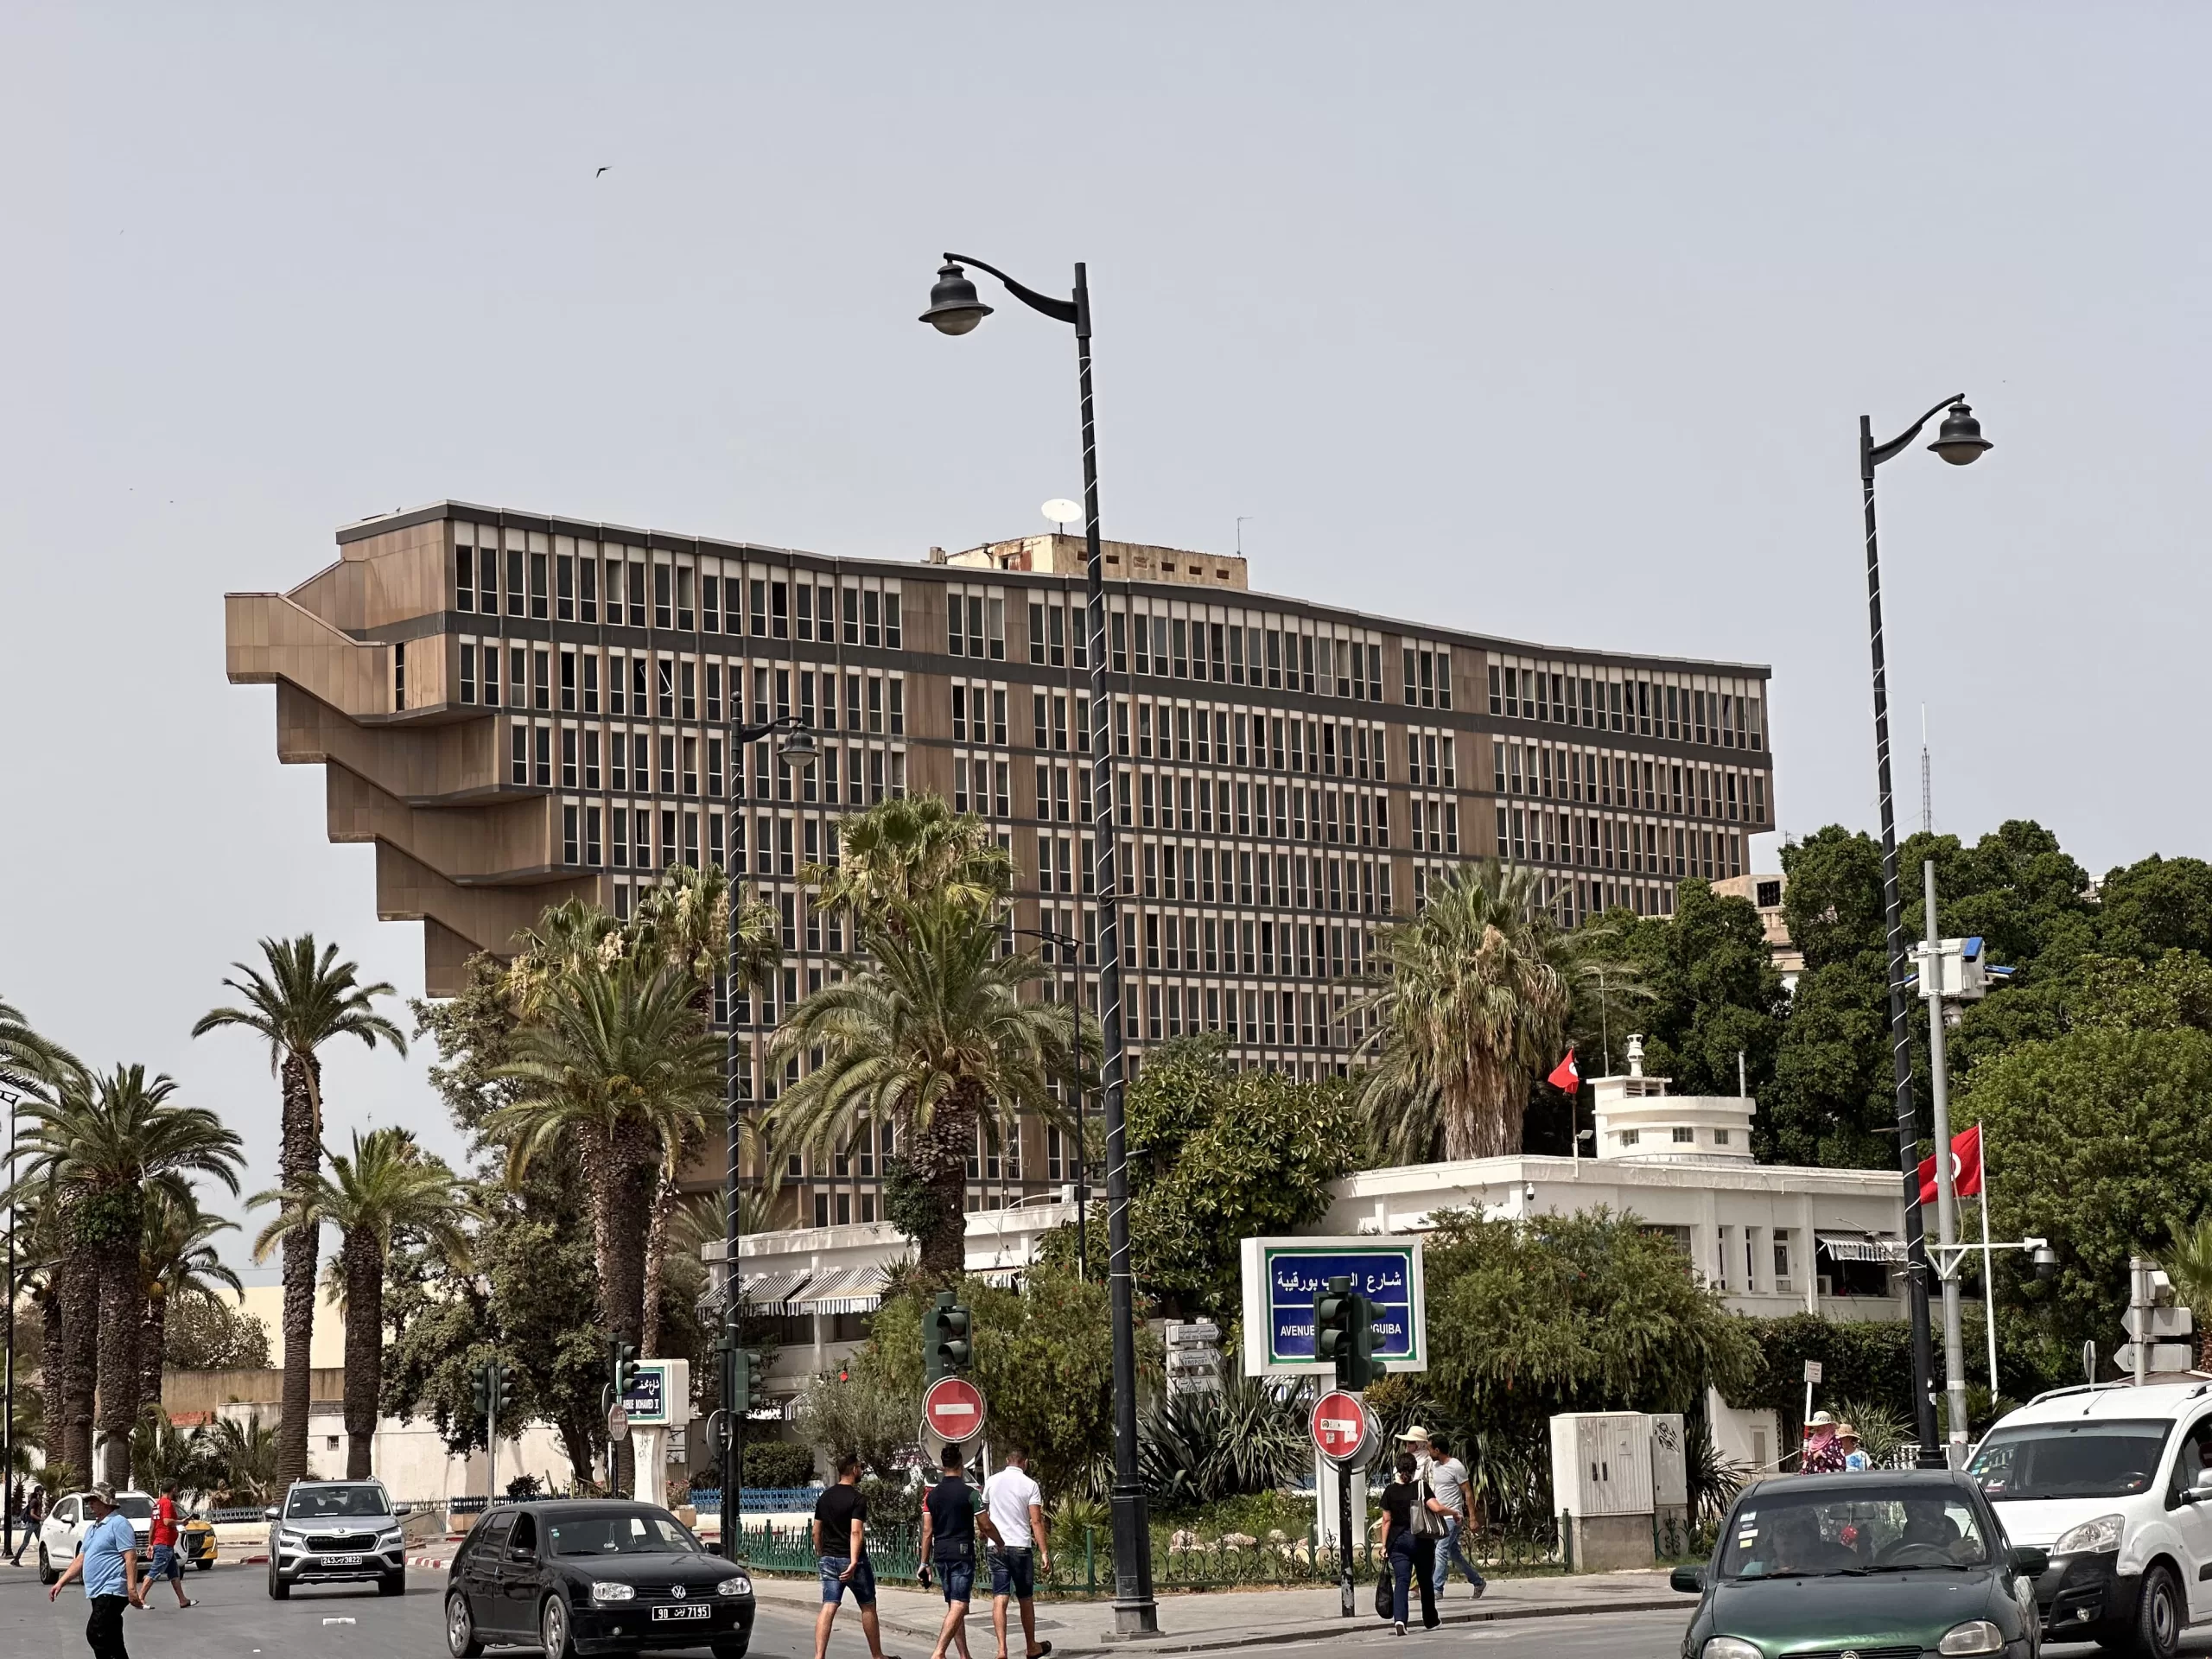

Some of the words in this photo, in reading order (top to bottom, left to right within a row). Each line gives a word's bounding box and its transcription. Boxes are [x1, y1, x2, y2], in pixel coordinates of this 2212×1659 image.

[1277, 1271, 1318, 1292] بورقيبة
[1321, 1272, 1357, 1292] الب
[1366, 1271, 1402, 1294] شارع
[1280, 1325, 1315, 1337] AVENUE
[1371, 1324, 1402, 1335] GUIBA
[635, 1399, 654, 1409] MOHAMED
[613, 1424, 626, 1433] STOP
[658, 1608, 669, 1619] 90
[688, 1607, 707, 1618] 7195
